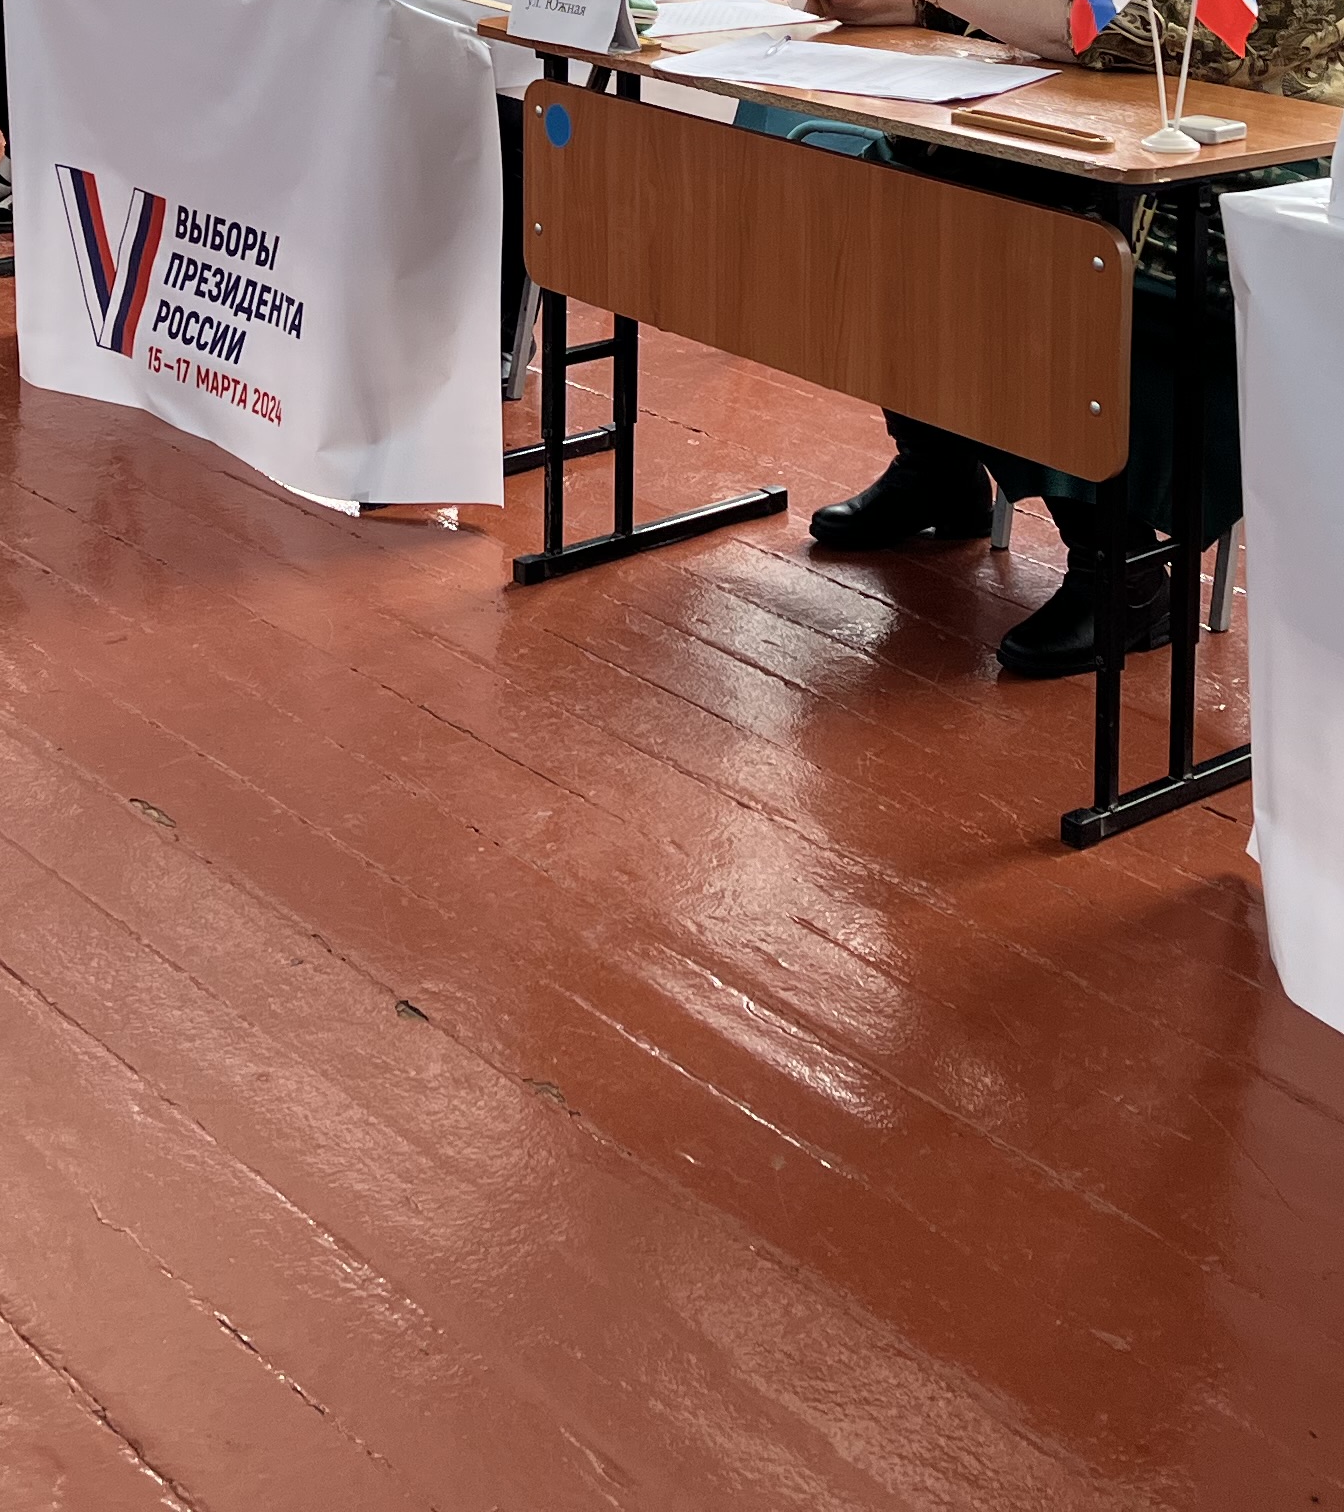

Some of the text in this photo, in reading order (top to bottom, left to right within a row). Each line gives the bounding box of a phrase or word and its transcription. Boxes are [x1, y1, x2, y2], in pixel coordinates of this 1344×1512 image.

[175, 204, 280, 271] ВЫБОРЫ
[163, 251, 305, 340] ПРЕЗИДЕНТА
[151, 298, 247, 365] РОССИИ
[196, 364, 248, 410] МАРТА
[251, 387, 283, 427] 2024
